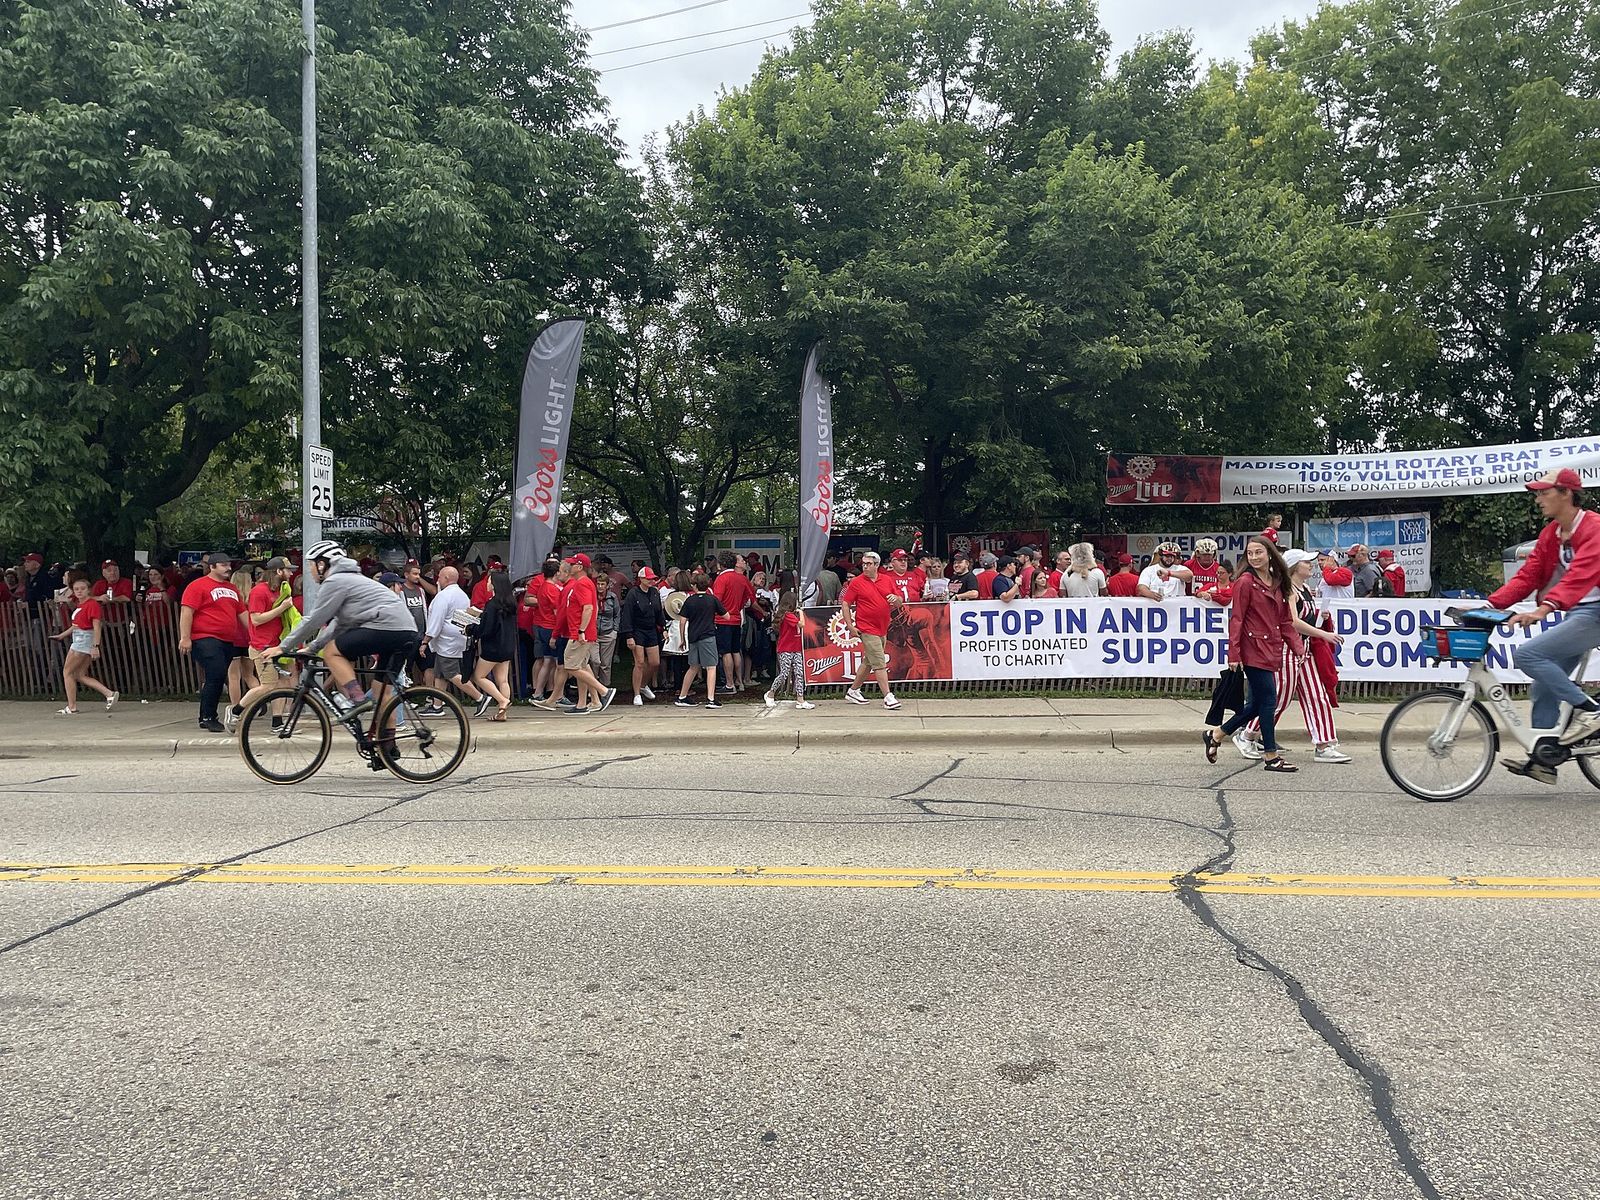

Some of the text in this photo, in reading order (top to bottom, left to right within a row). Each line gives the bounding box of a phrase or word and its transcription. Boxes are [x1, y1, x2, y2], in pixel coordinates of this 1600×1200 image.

[310, 452, 332, 467] SPEED
[523, 377, 567, 522] Coors LIGHT
[1225, 461, 1315, 470] MADISON
[1321, 460, 1388, 471] SOUTH
[1395, 454, 1479, 469] ROTARY
[1485, 448, 1543, 464] BRAT
[811, 392, 832, 533] Coors LIGHT
[1298, 460, 1539, 482] 100% VOLUNTEER RUN
[313, 467, 329, 481] LIMIT
[1233, 485, 1257, 496] ALL
[1261, 483, 1316, 495] PROFITS
[1320, 483, 1346, 492] ARE
[1351, 481, 1416, 492] DONATED
[1421, 478, 1461, 488] BACK
[1464, 478, 1482, 487] TO
[1487, 473, 1519, 485] OUR
[312, 485, 332, 512] 25
[1135, 480, 1173, 503] Lite
[1370, 529, 1393, 537] GOING
[1400, 527, 1424, 536] YORK
[1403, 521, 1423, 530] NEW
[1403, 533, 1422, 542] LIFE
[1400, 547, 1424, 557] CLTC
[959, 607, 1441, 637] STOP IN AND HE DISON
[959, 637, 1088, 653] PROFITS DONATED
[1101, 638, 1230, 665] SUPPOR
[806, 655, 842, 676] Miller
[982, 653, 1065, 667] TO CHARITY
